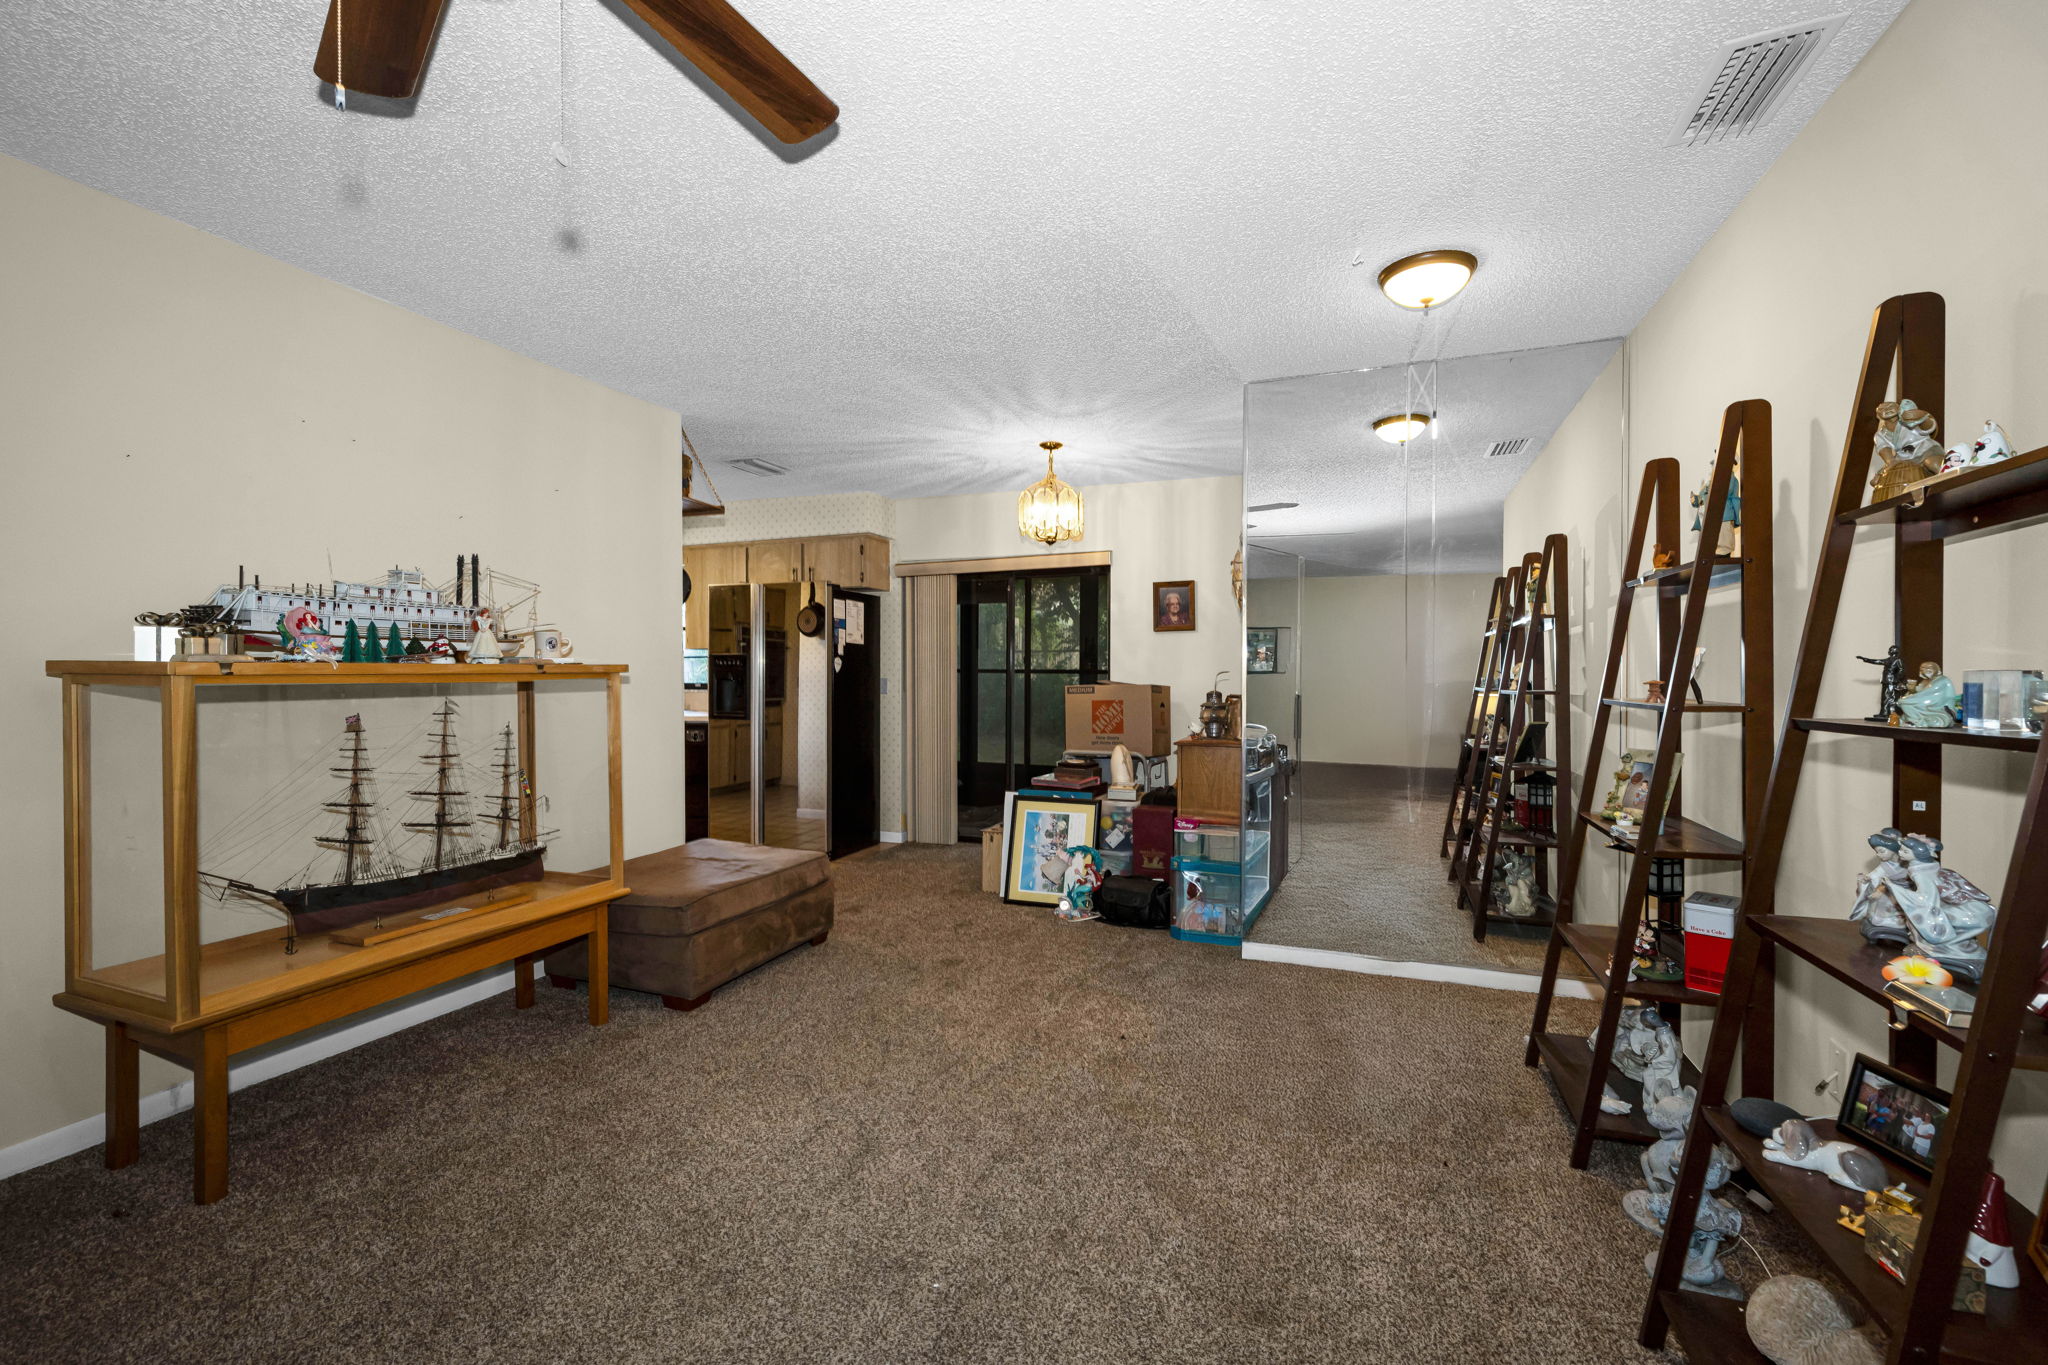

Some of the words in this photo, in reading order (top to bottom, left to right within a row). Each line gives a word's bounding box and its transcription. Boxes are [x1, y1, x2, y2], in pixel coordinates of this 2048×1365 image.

[1092, 699, 1123, 733] HOME
[1096, 704, 1107, 716] THE
[1104, 711, 1124, 734] DEPOT
[1176, 820, 1195, 829] Disney
